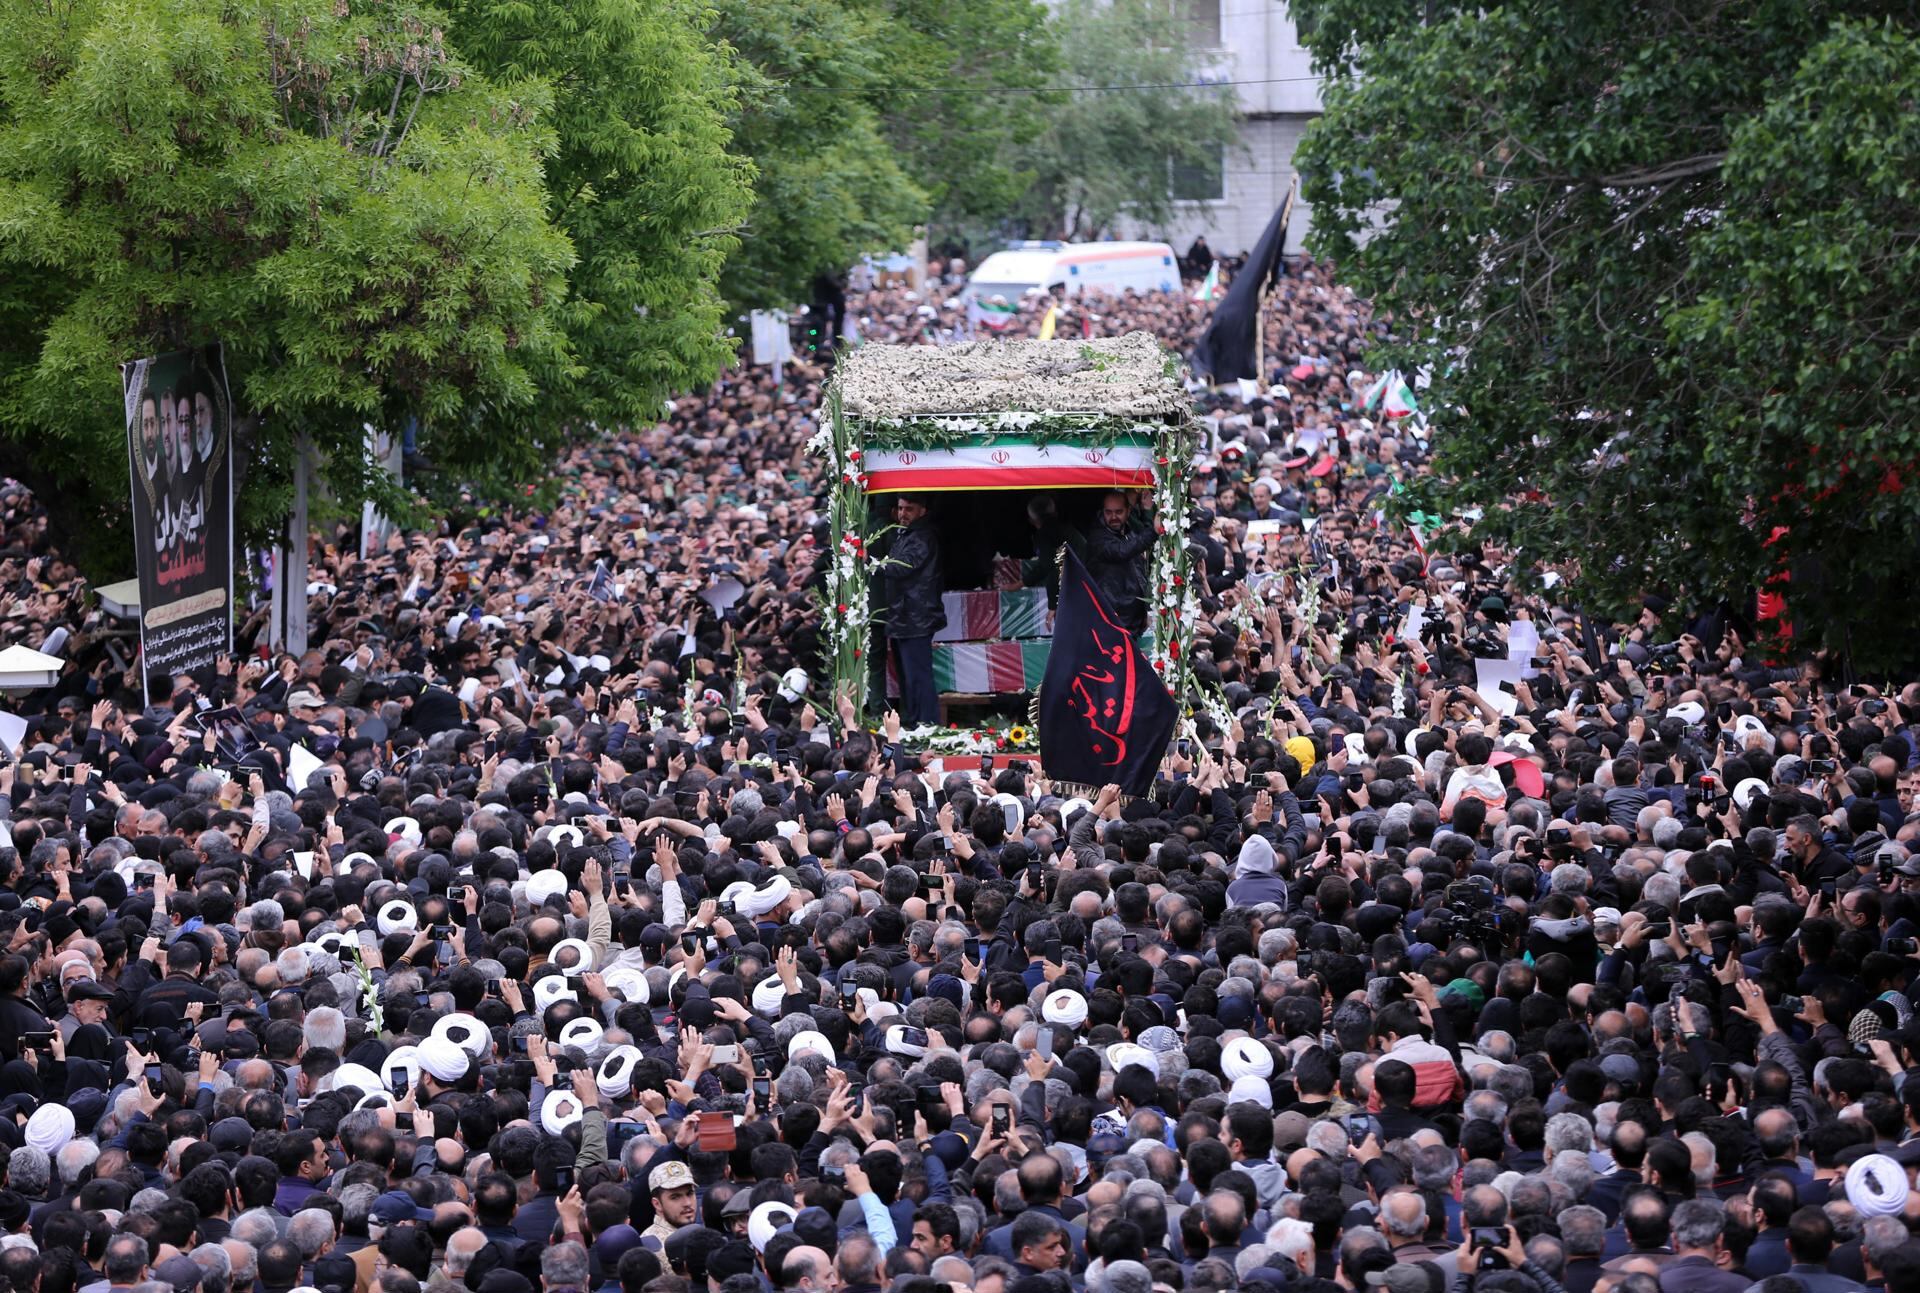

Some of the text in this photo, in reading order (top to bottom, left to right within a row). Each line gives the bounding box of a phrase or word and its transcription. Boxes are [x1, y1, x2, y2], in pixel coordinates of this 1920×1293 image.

[155, 484, 205, 552] ایران
[156, 534, 206, 594] تسلیت
[1068, 676, 1127, 766] حسین
